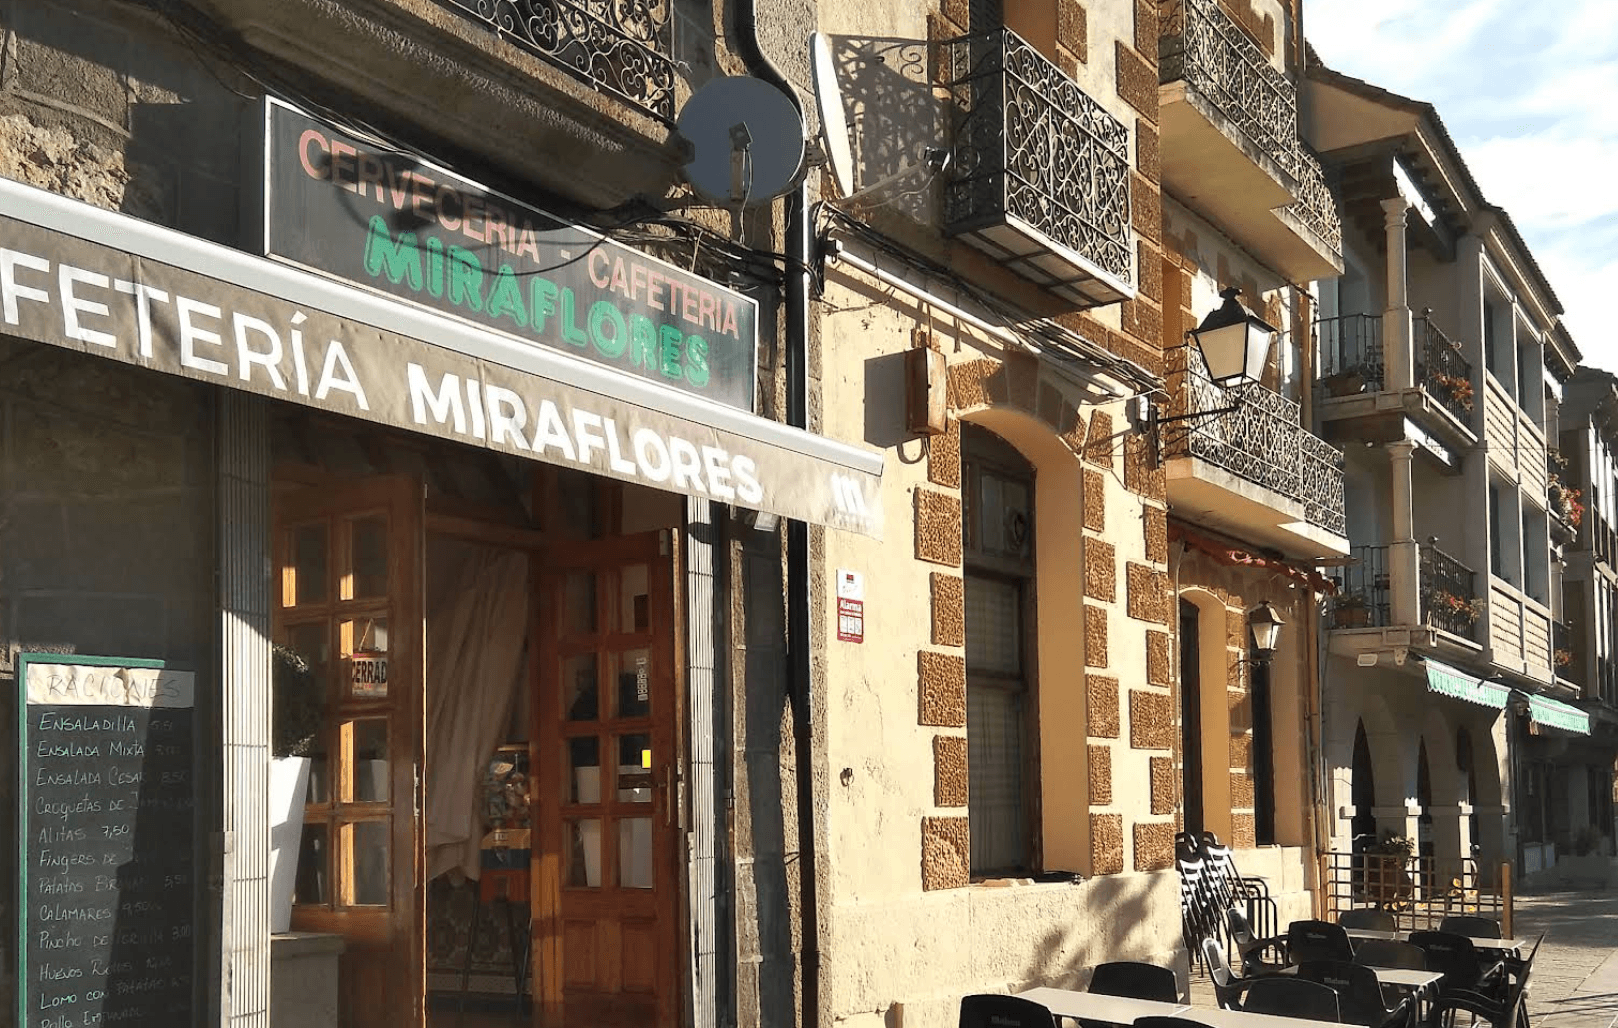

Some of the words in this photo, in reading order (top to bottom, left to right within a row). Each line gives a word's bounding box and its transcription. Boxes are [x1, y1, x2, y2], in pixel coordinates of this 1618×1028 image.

[299, 129, 540, 264] CERVECERIA
[588, 248, 740, 341] CAFETERIA
[364, 214, 710, 388] MIRAFLORES
[0, 247, 370, 411] FETERÍA
[407, 362, 764, 505] MIRAFLORES
[48, 674, 180, 701] RACIONES
[36, 767, 100, 786] ENSALADA
[37, 741, 100, 757] ENSALADA
